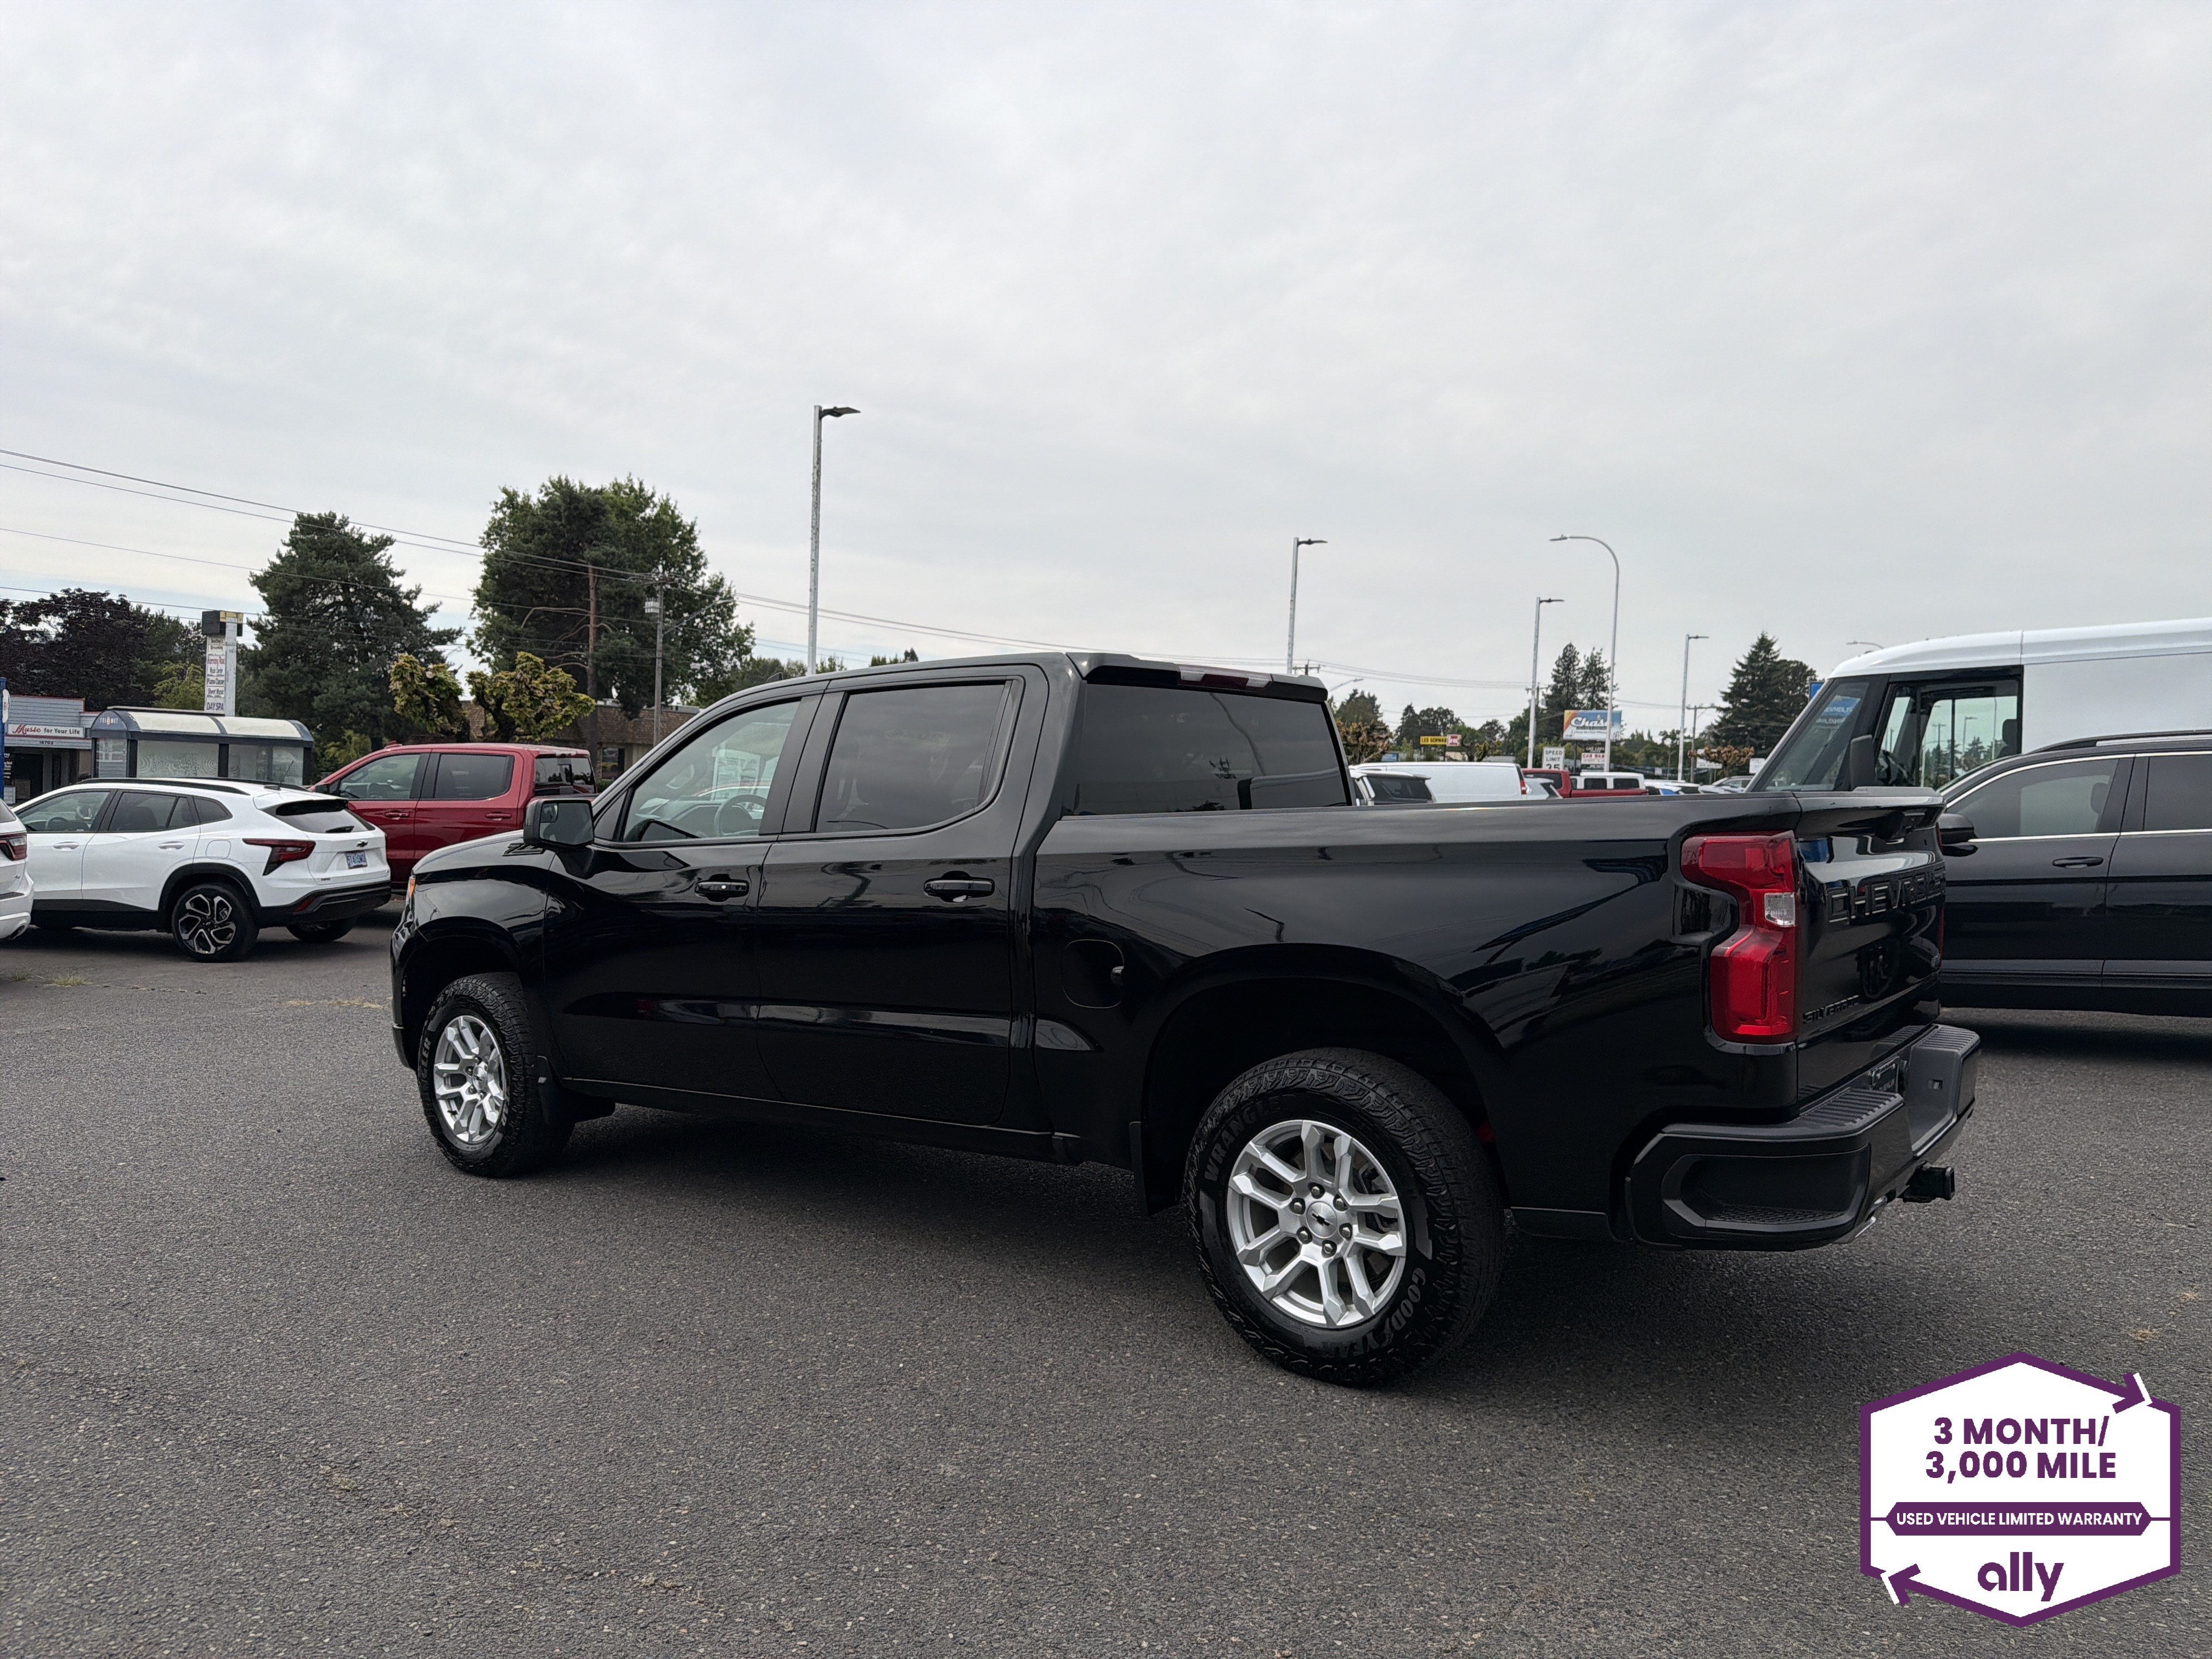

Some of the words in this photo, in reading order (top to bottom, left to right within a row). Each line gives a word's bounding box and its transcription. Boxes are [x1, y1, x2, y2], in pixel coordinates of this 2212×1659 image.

[206, 702, 216, 710] DAY
[216, 702, 224, 711] SPA
[12, 724, 41, 735] Music
